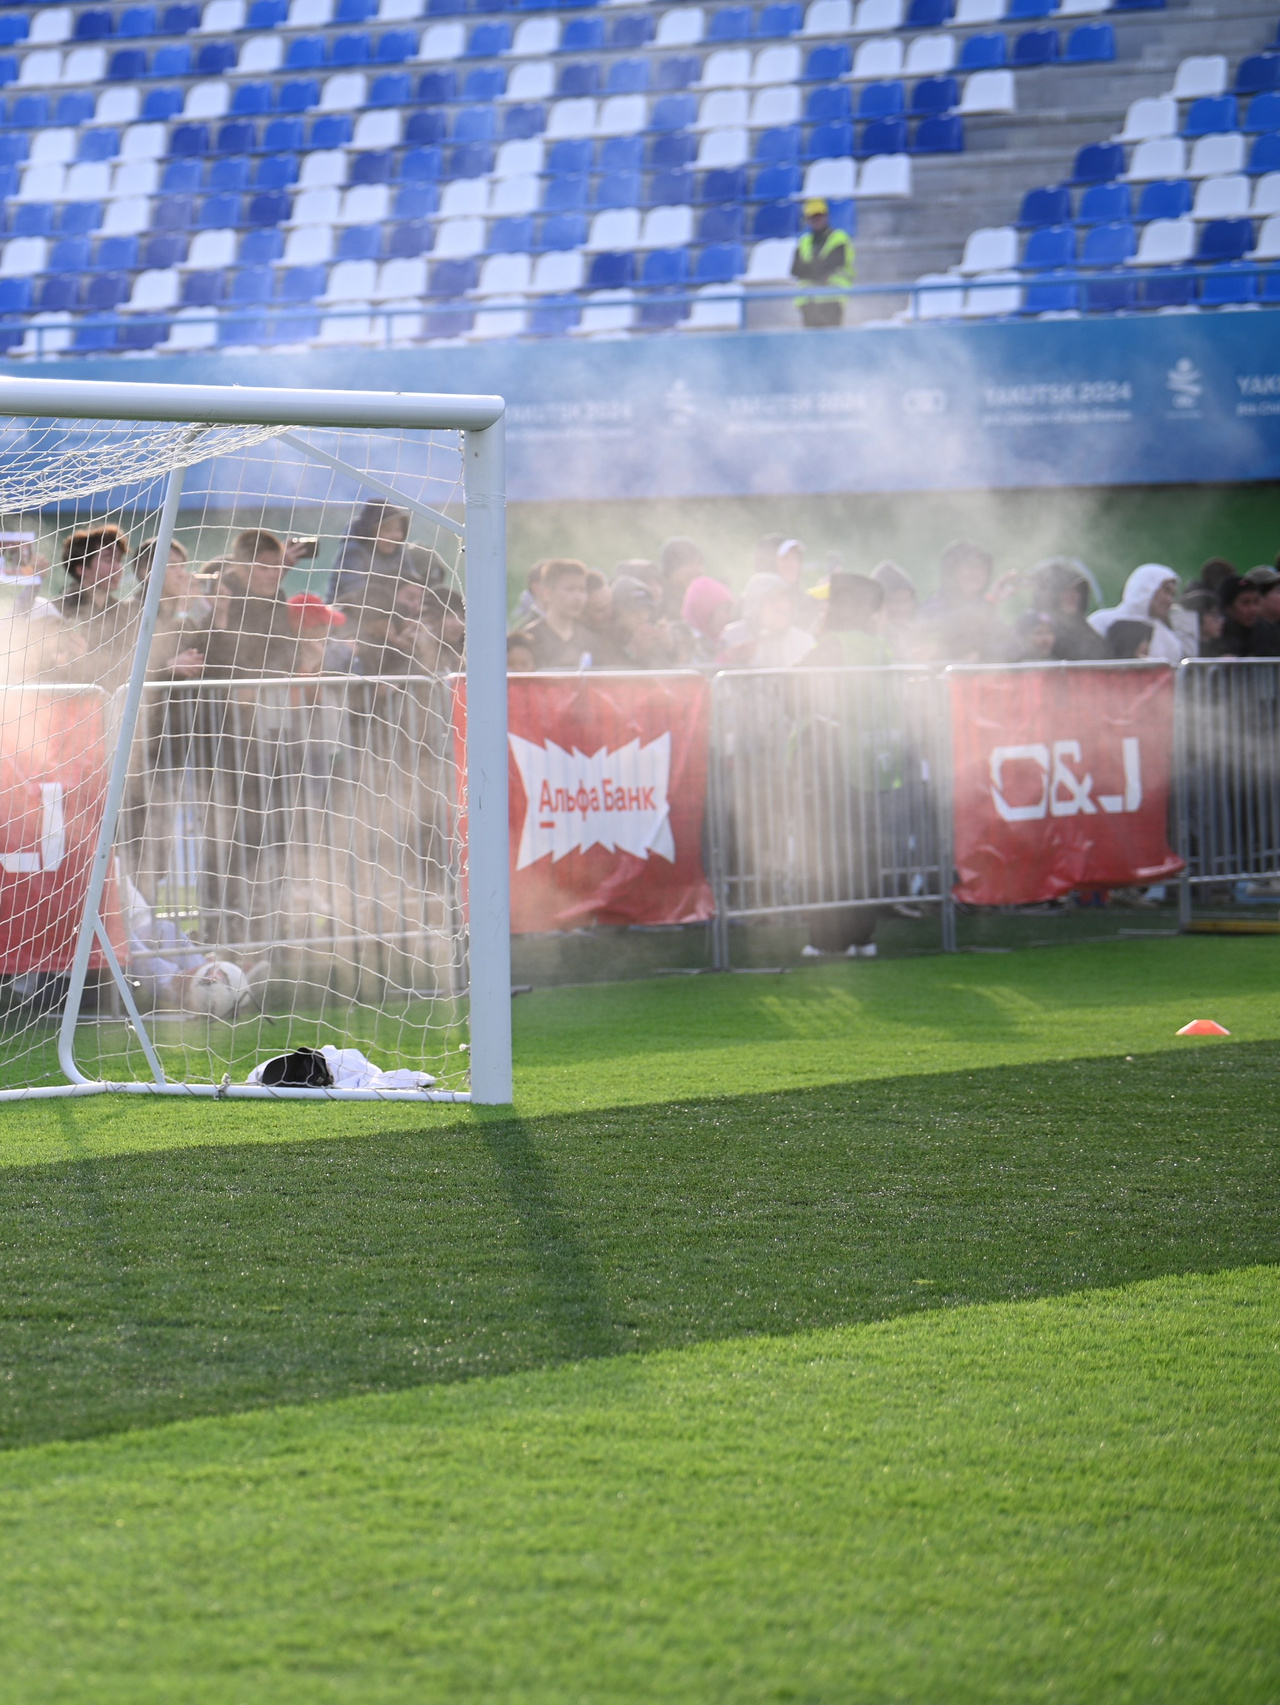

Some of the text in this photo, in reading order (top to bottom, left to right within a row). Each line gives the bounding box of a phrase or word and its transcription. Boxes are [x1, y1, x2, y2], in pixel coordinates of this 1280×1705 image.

[539, 778, 657, 823] Альфа Банк
[989, 736, 1142, 823] O&J
